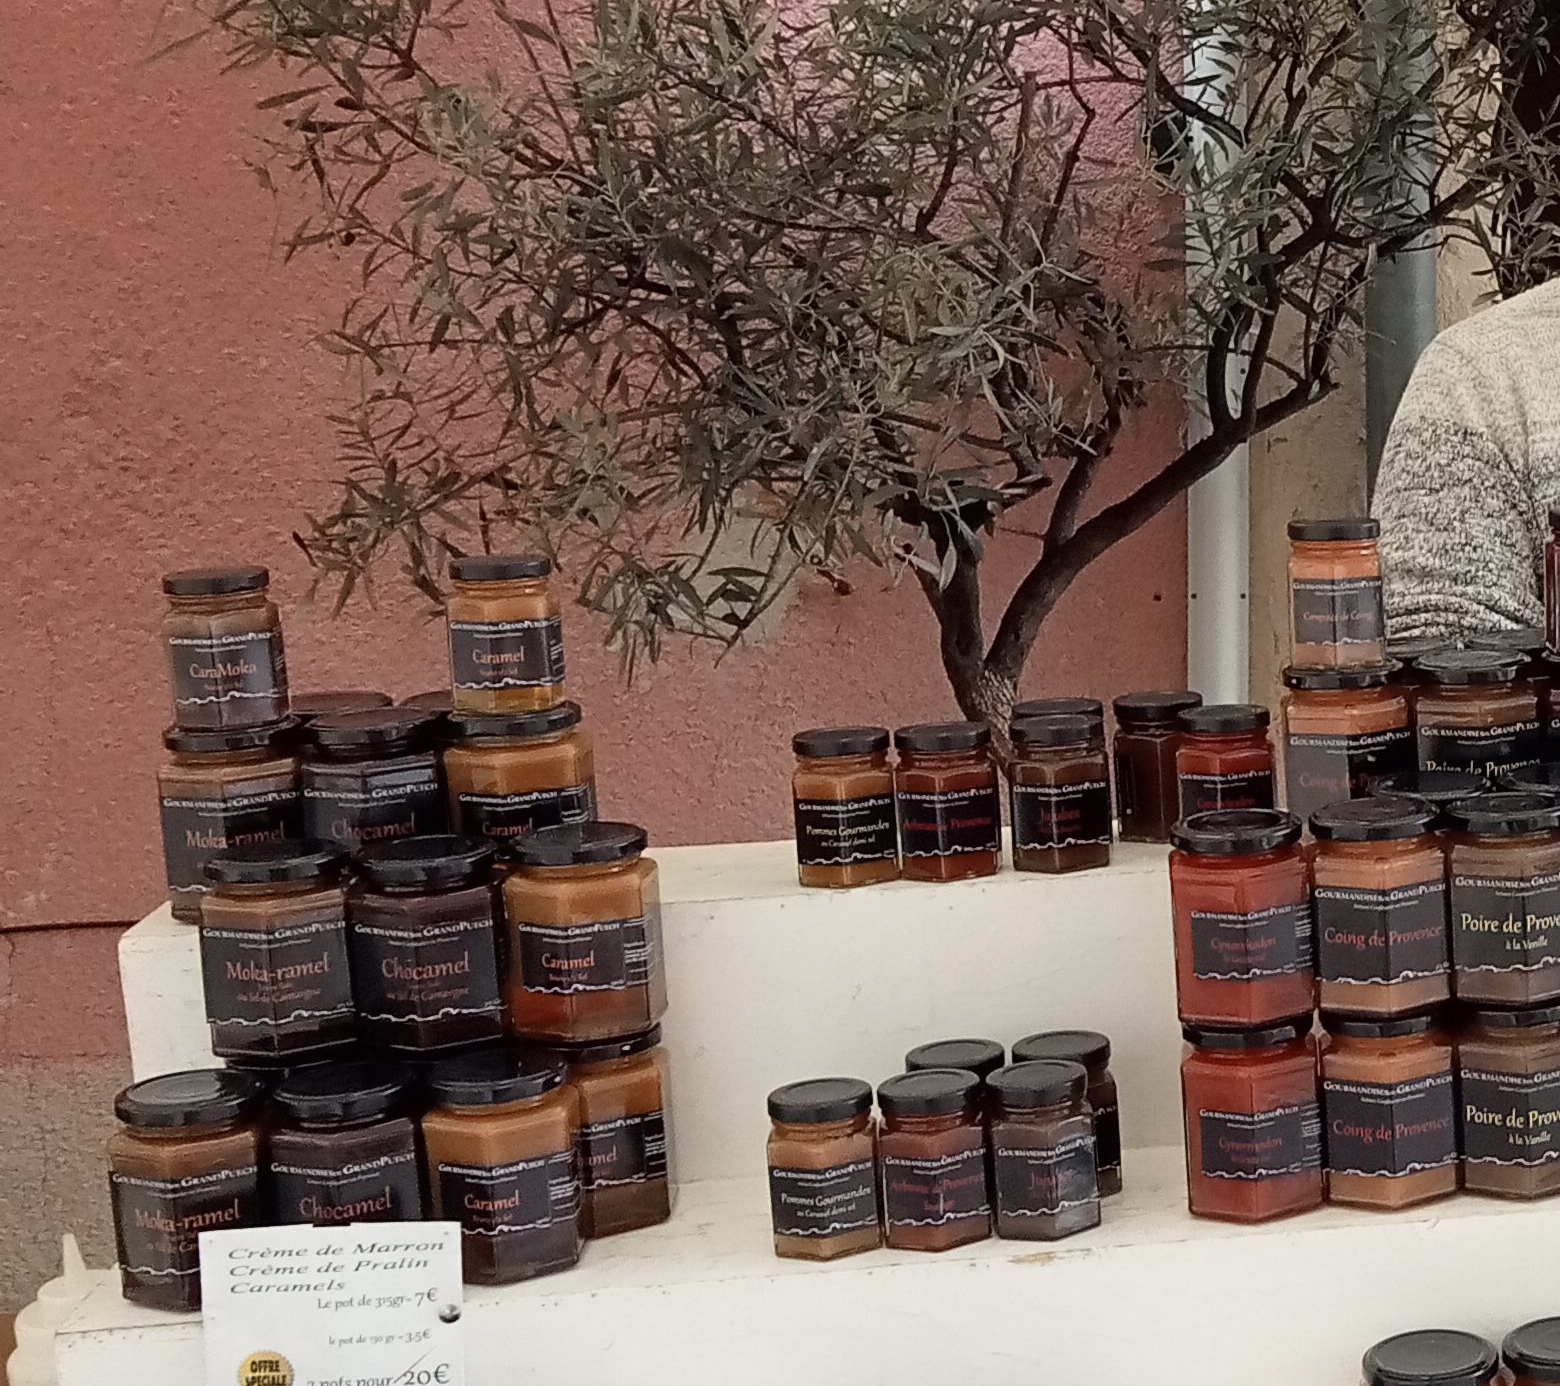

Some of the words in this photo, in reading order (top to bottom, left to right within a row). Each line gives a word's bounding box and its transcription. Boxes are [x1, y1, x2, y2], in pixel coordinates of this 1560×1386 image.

[472, 646, 525, 666] Caramel
[188, 658, 257, 680] CaraMoka
[185, 820, 285, 850] Moka-ramel
[330, 813, 416, 842] Chocamel
[1460, 912, 1500, 933] Poire
[1502, 912, 1522, 934] de
[1324, 927, 1366, 950] Coing
[1368, 928, 1386, 947] de
[225, 951, 331, 982] Moka-ramel
[381, 950, 470, 981] Chocamel
[541, 949, 595, 970] Caramel
[1465, 1104, 1502, 1126] Poire
[1505, 1107, 1525, 1129] de
[1332, 1119, 1374, 1142] Coing
[1376, 1123, 1392, 1141] de
[1514, 1132, 1523, 1145] la
[299, 1188, 392, 1223] Chocamel
[464, 1190, 521, 1213] Caramel
[135, 1198, 241, 1231] Moka-ramel
[228, 1245, 308, 1260] Crème
[316, 1244, 344, 1258] de
[351, 1240, 445, 1255] Marron
[229, 1262, 308, 1277] Crème
[317, 1261, 345, 1274] de
[353, 1257, 430, 1272] Pralin
[230, 1279, 346, 1294] Caramels
[317, 1298, 331, 1309] Le
[335, 1297, 354, 1311] pot
[359, 1295, 372, 1307] de
[414, 1288, 440, 1308] 7€
[250, 1359, 281, 1374] OFFRE
[403, 1363, 450, 1386] 20€
